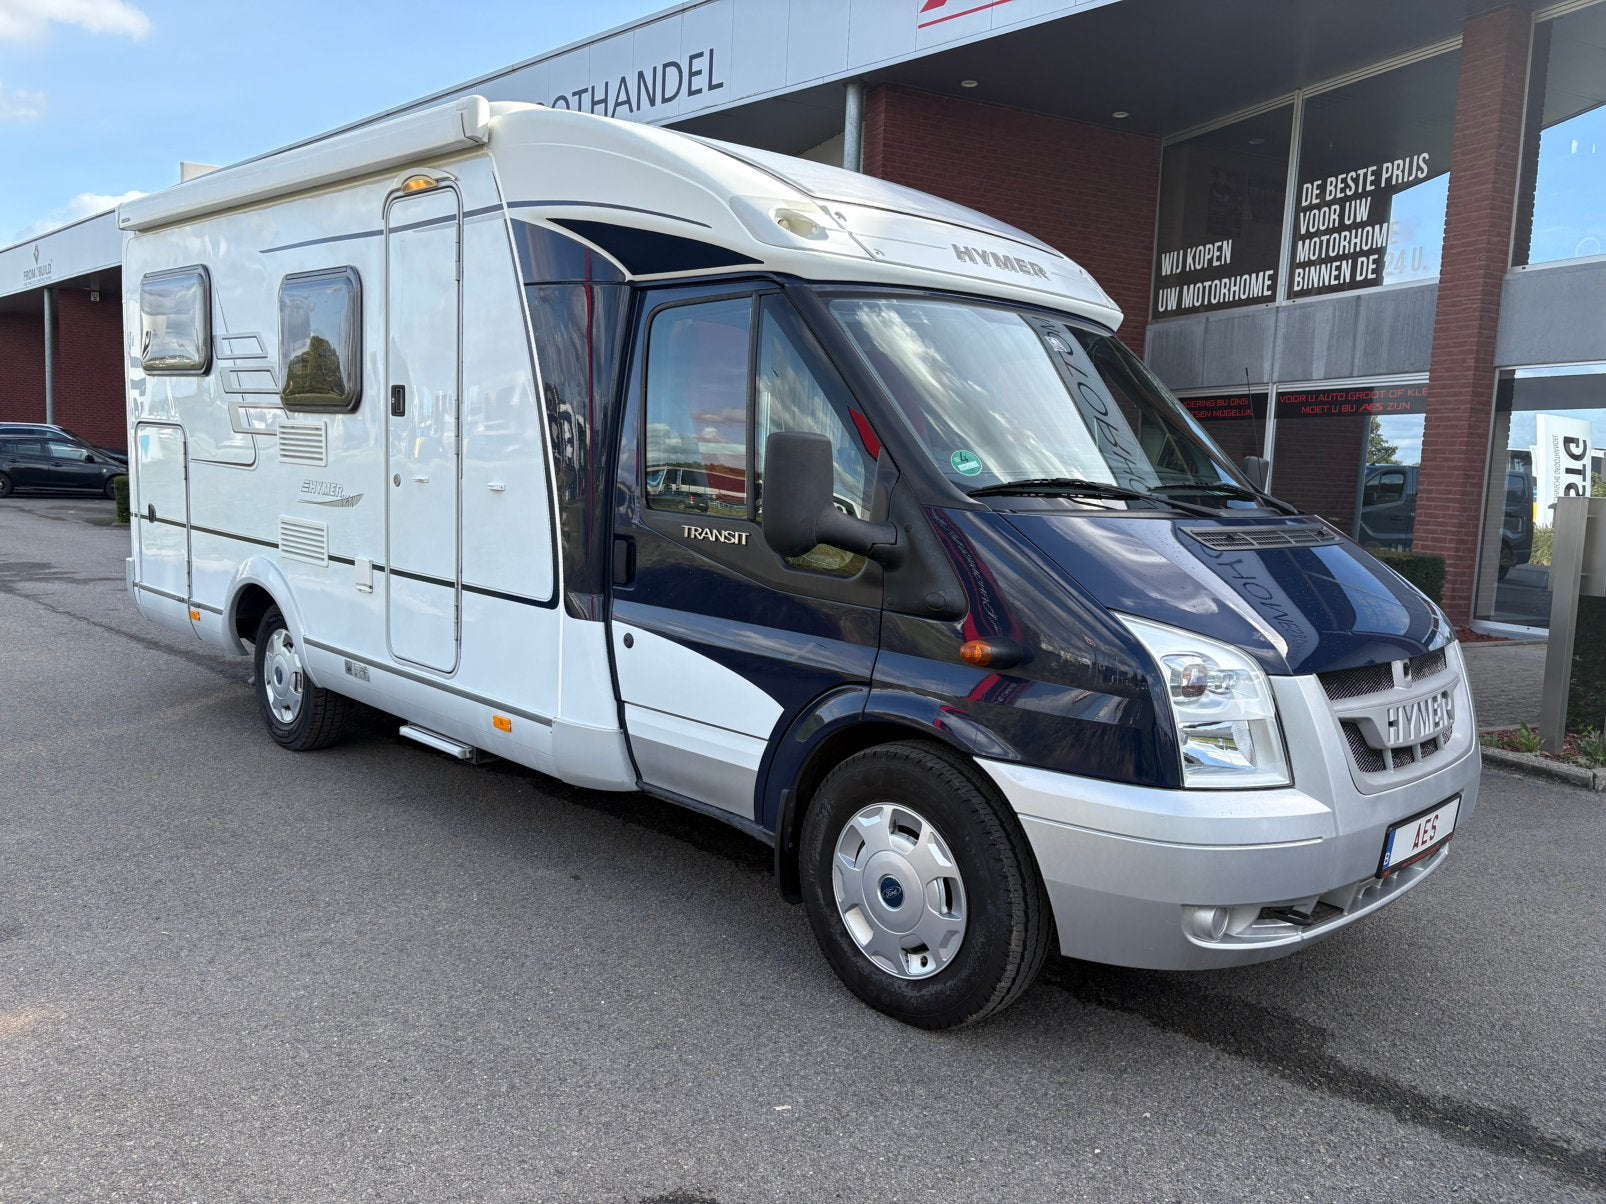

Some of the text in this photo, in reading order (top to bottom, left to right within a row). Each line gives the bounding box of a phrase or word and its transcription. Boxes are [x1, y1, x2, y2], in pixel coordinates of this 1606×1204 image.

[1302, 153, 1430, 206] DE BESTE PRIJS
[1300, 197, 1371, 235] VOOR UW
[951, 243, 1051, 282] HYMER
[1161, 239, 1232, 276] WIJ KOPEN
[1293, 259, 1352, 291] BINNEN
[1356, 255, 1379, 281] DE
[1158, 270, 1274, 312] UW MOTORHOME
[1230, 397, 1249, 406] ONS
[1279, 395, 1306, 403] VOOR
[1318, 392, 1346, 402] AUTO
[1348, 390, 1386, 400] GROOT
[1389, 389, 1405, 398] OF
[1301, 404, 1329, 414] MOET
[960, 452, 969, 463] 4
[681, 524, 751, 546] TRANSIT
[1387, 690, 1453, 745] HYMER
[1412, 814, 1439, 851] AES
[1384, 852, 1390, 865] B
